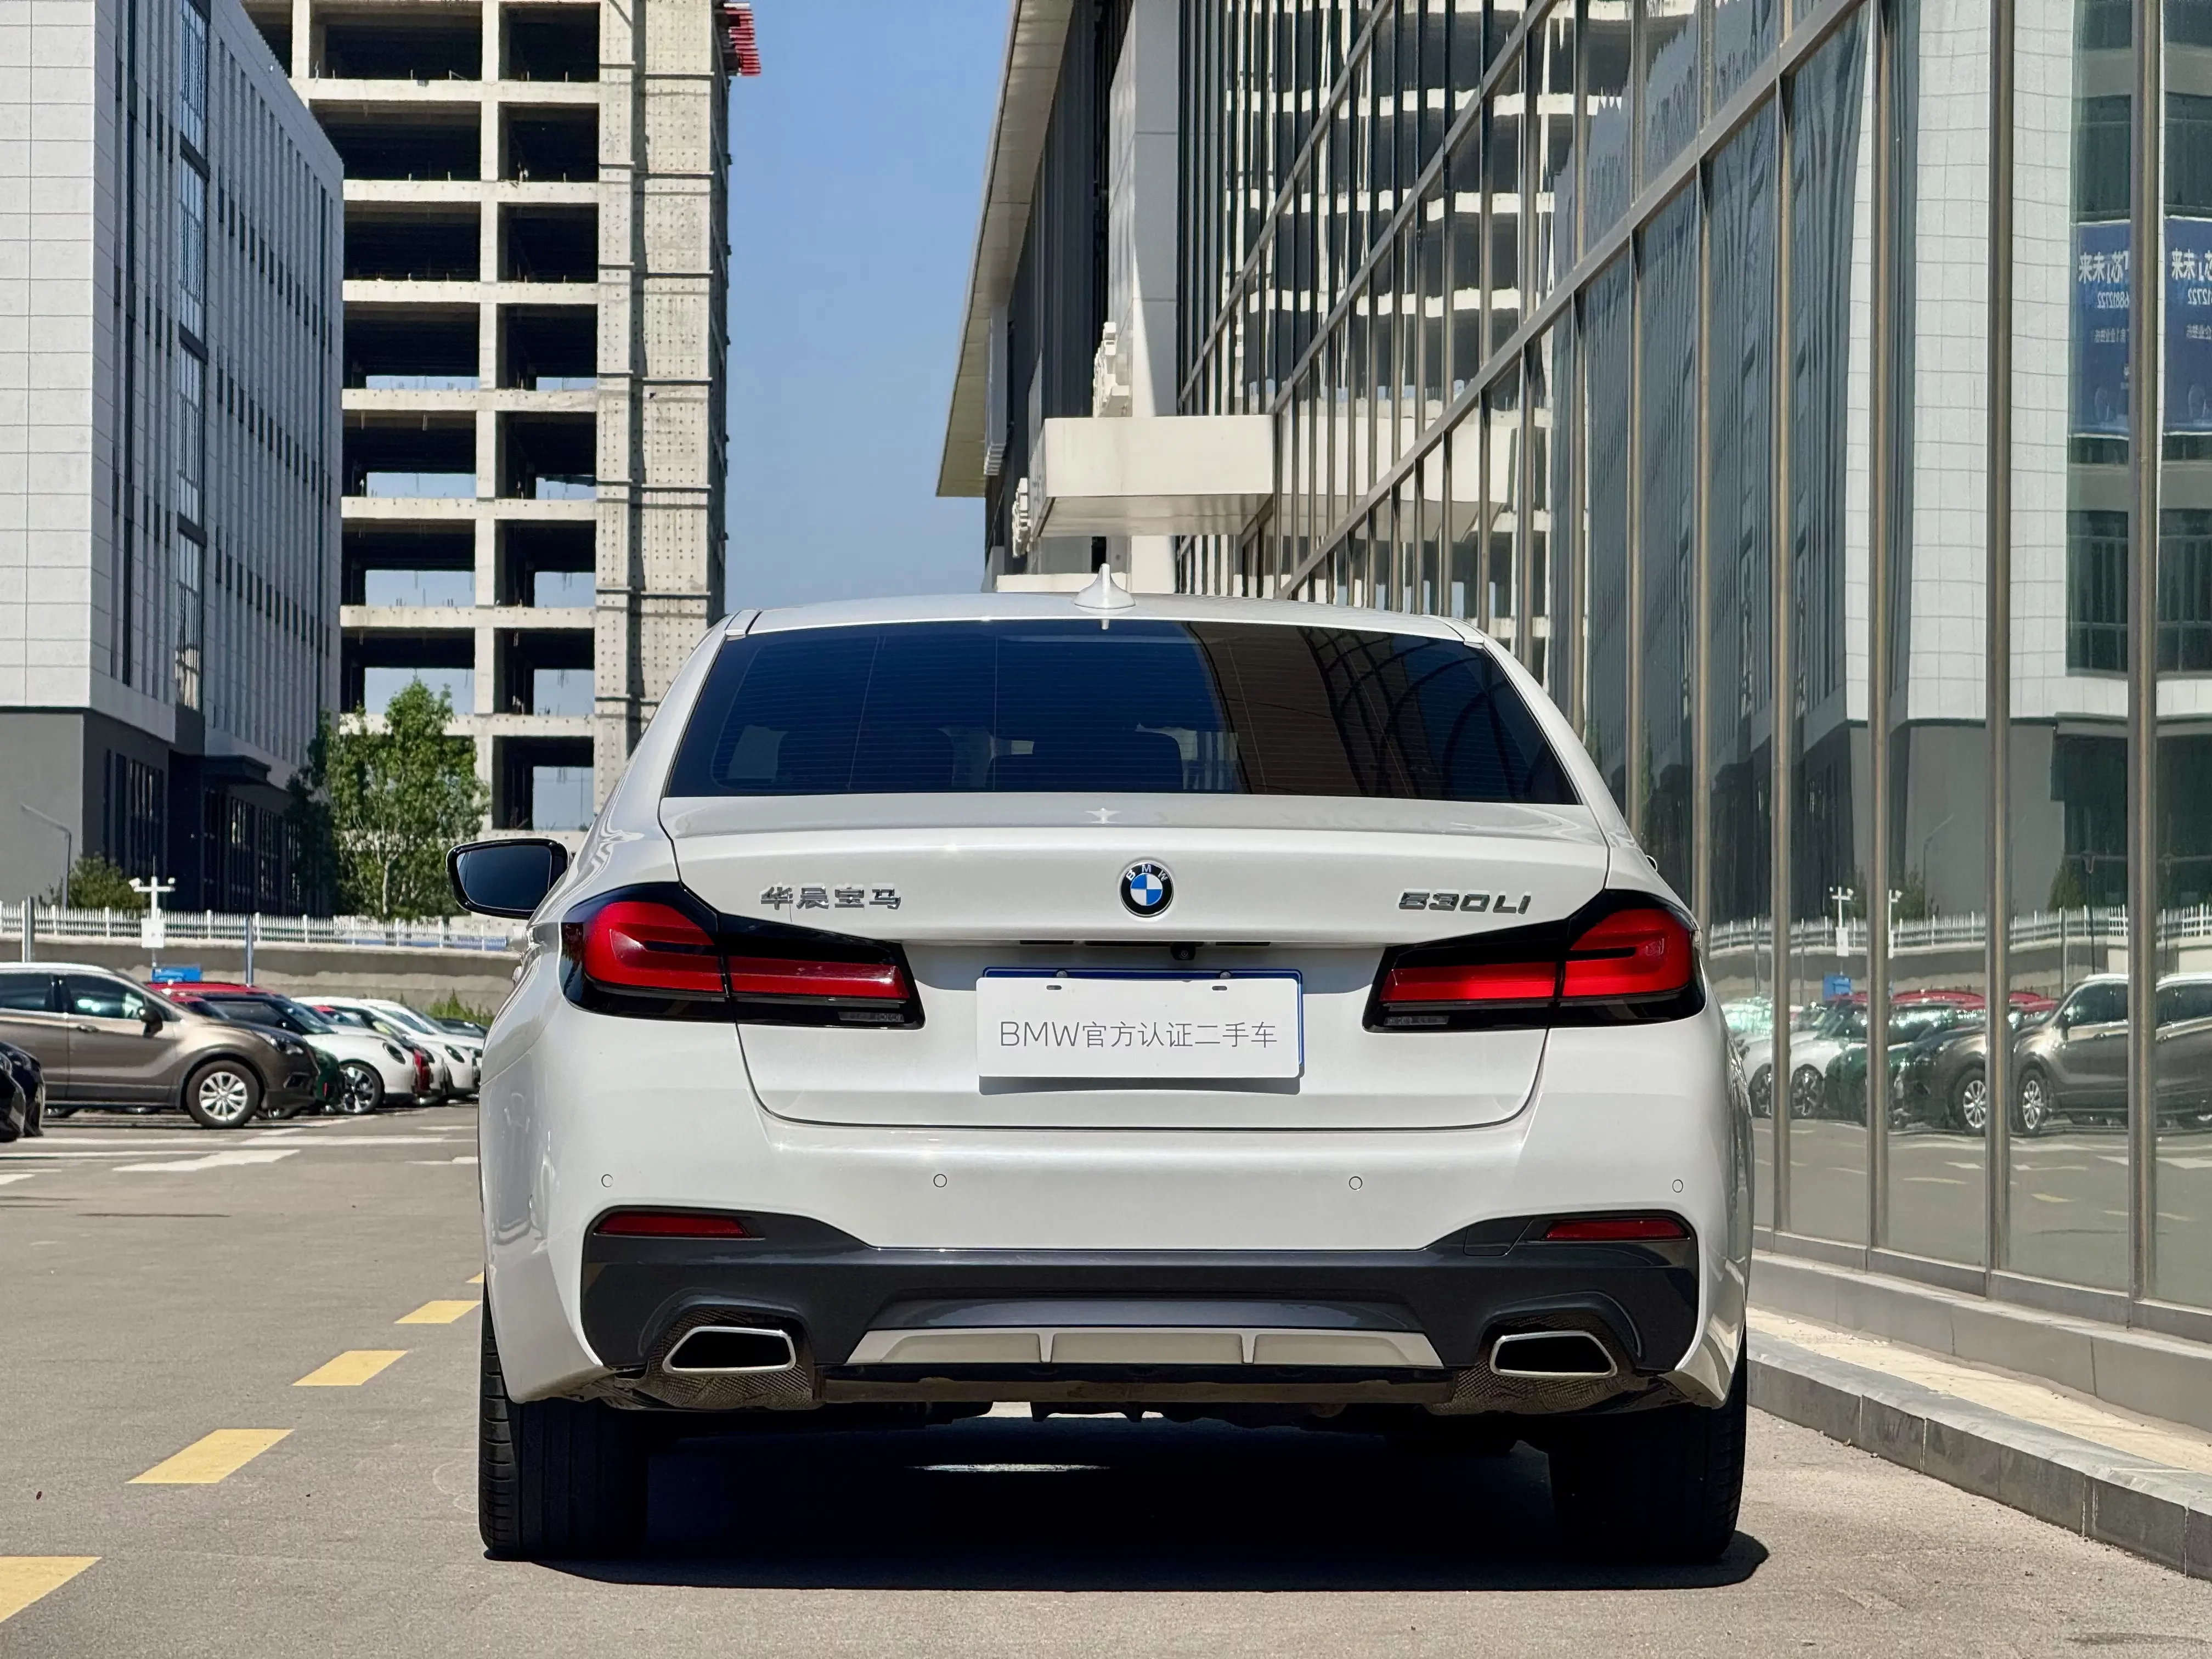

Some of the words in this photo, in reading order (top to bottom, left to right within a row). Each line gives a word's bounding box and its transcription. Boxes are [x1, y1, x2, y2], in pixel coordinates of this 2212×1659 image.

[1126, 864, 1169, 882] BMW
[760, 884, 901, 911] 华晨宝马
[1000, 1021, 1277, 1048] BMW官方认证二手车
